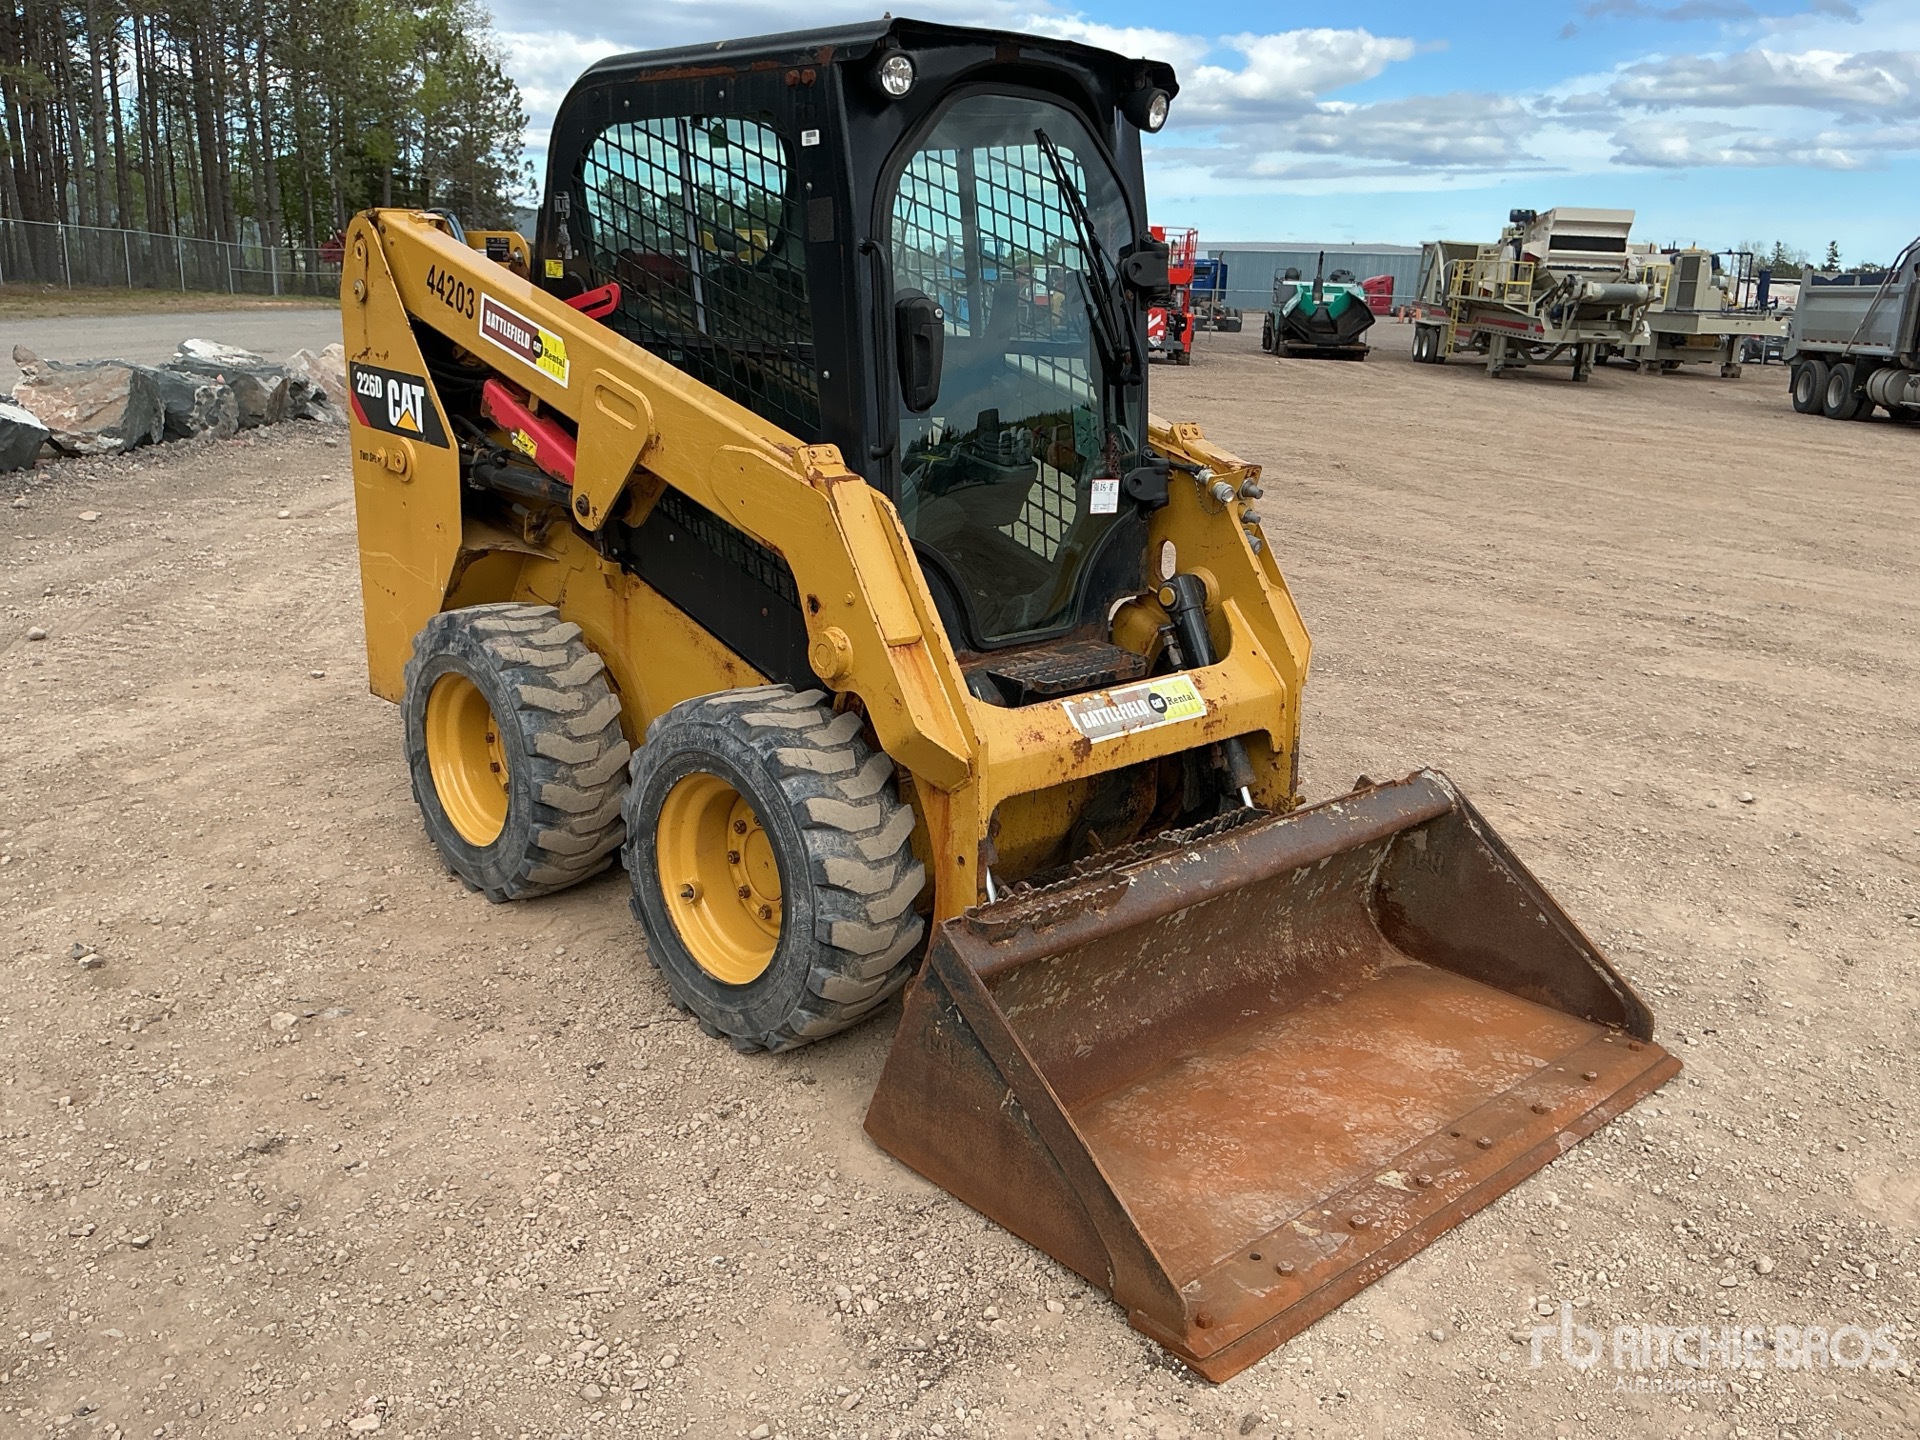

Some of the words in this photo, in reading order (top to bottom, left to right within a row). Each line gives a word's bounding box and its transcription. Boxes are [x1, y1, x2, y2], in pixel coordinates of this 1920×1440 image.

[426, 264, 475, 320] 44203
[485, 309, 531, 350] BATTLEFIELD
[532, 340, 542, 353] CAT
[543, 347, 566, 368] Rental
[356, 371, 383, 399] 226D
[387, 379, 425, 434] CAT
[1079, 699, 1150, 729] BATTLEFIELD
[1166, 692, 1196, 706] Rental
